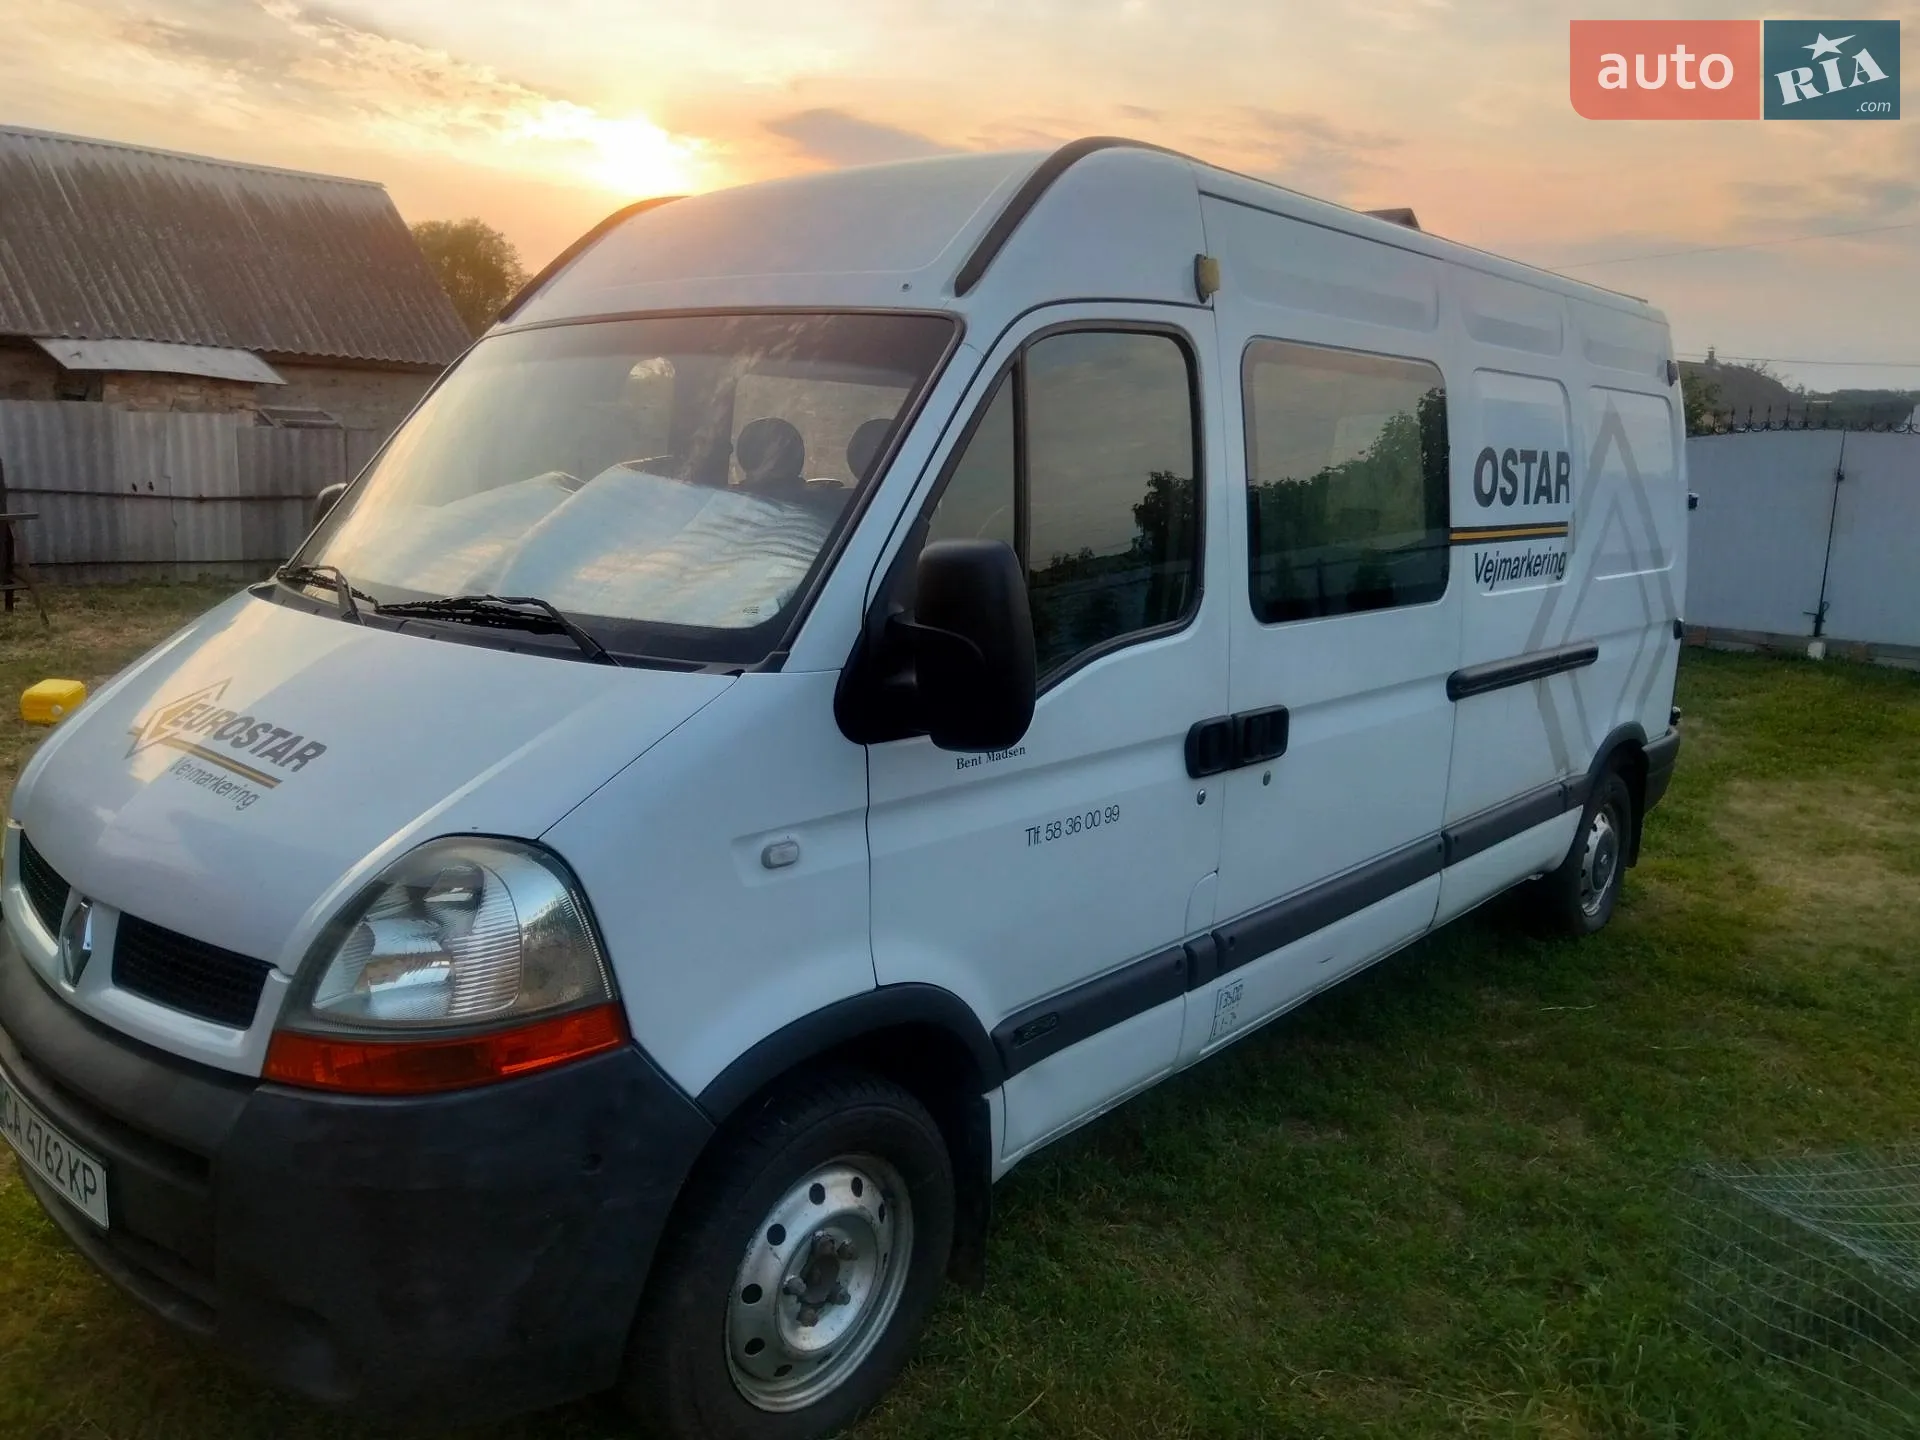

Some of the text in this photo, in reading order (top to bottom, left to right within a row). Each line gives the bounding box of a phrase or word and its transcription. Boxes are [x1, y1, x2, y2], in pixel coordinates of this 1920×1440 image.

[1473, 446, 1571, 508] OSTAR
[1474, 546, 1568, 591] Vejmarkering
[169, 702, 328, 773] EUROSTAR
[956, 746, 1026, 770] Bent Madsen
[1045, 820, 1062, 841] 58
[1065, 815, 1082, 835] 36
[1085, 810, 1101, 830] 00
[1104, 804, 1120, 824] 99
